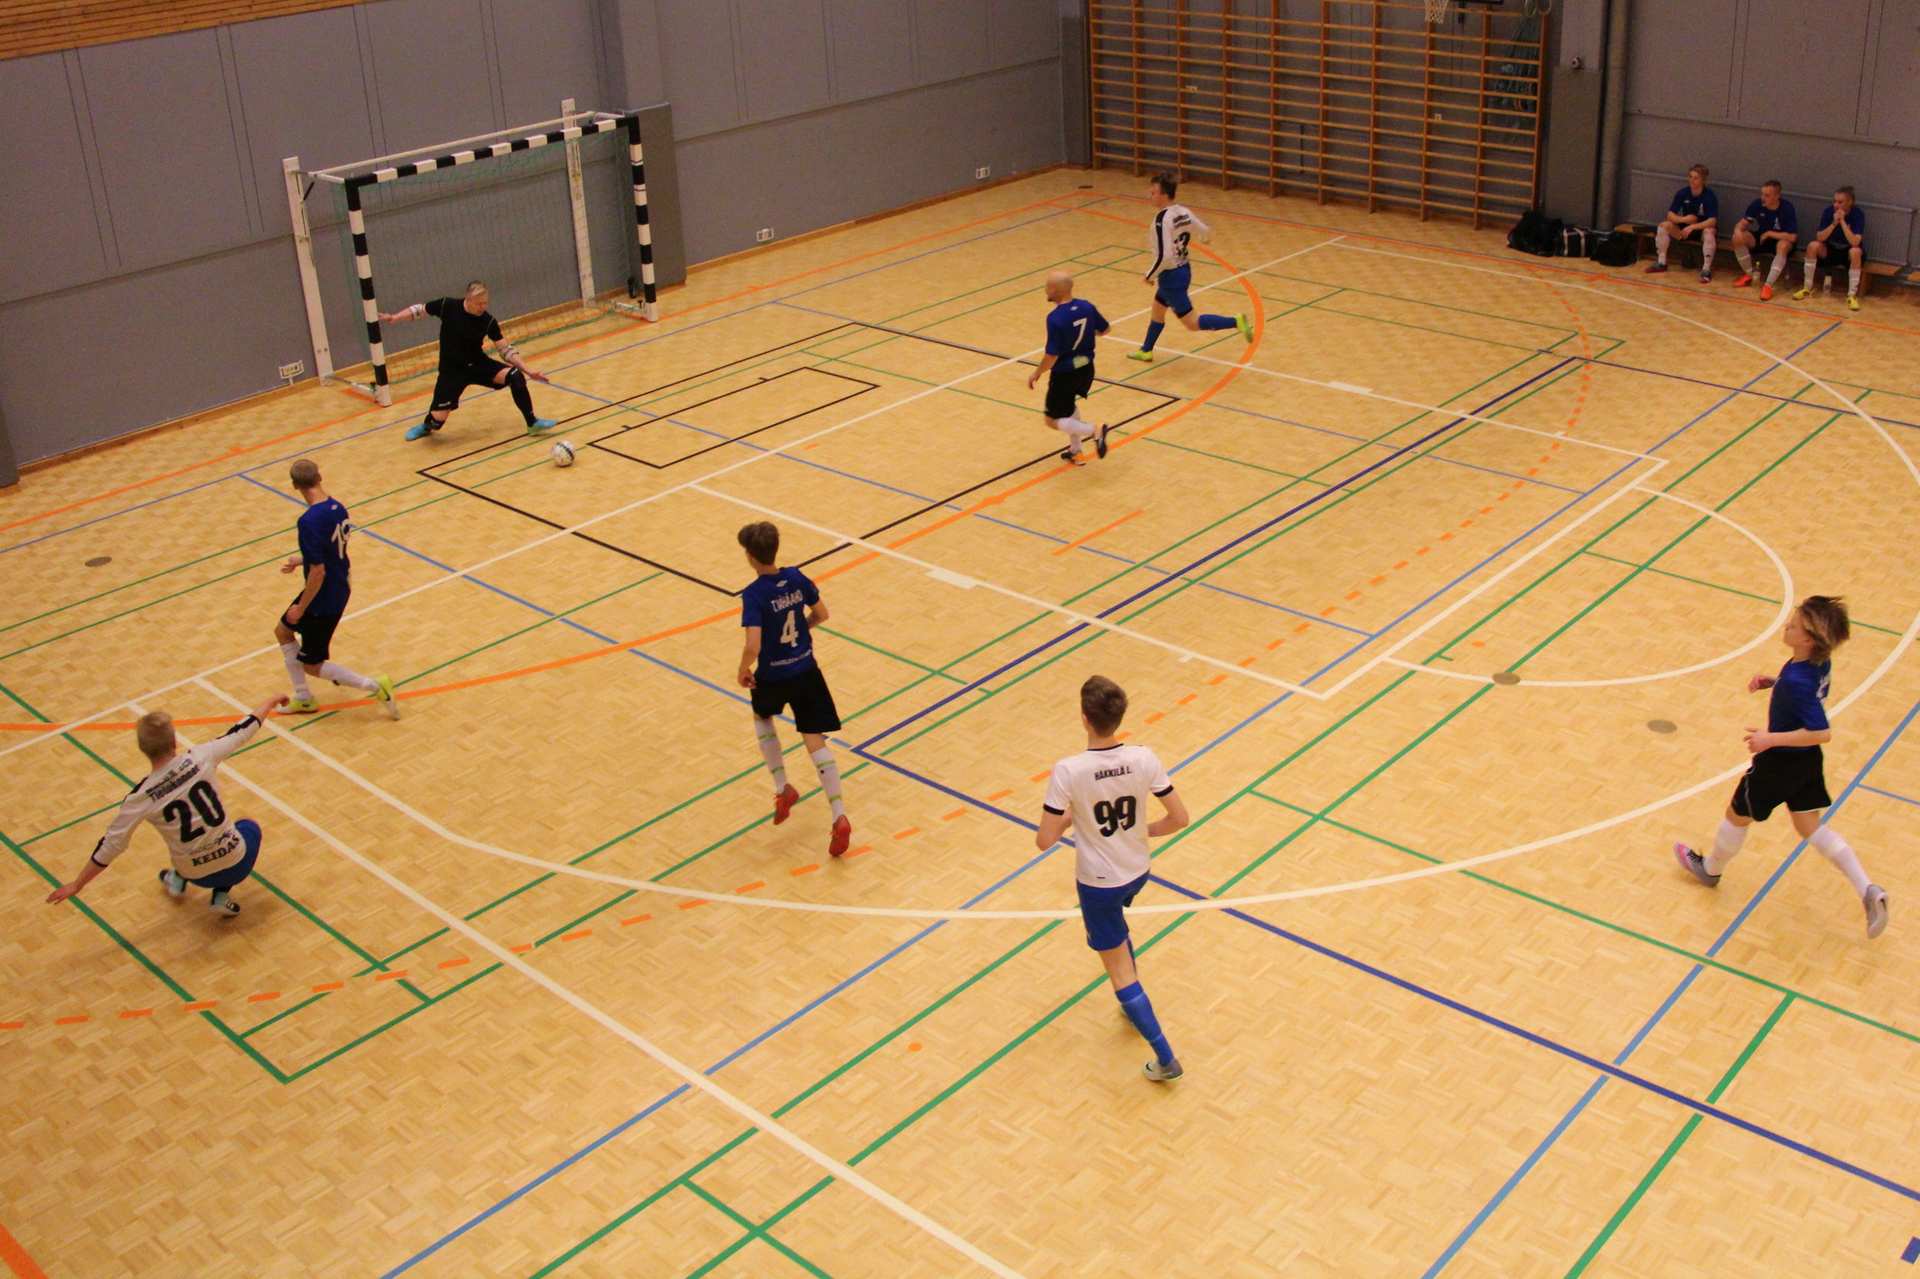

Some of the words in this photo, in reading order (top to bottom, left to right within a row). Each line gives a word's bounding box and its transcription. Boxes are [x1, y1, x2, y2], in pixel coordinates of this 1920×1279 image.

[1071, 317, 1088, 351] 7
[780, 609, 799, 648] 4
[162, 779, 226, 843] 20
[1093, 795, 1137, 837] 99
